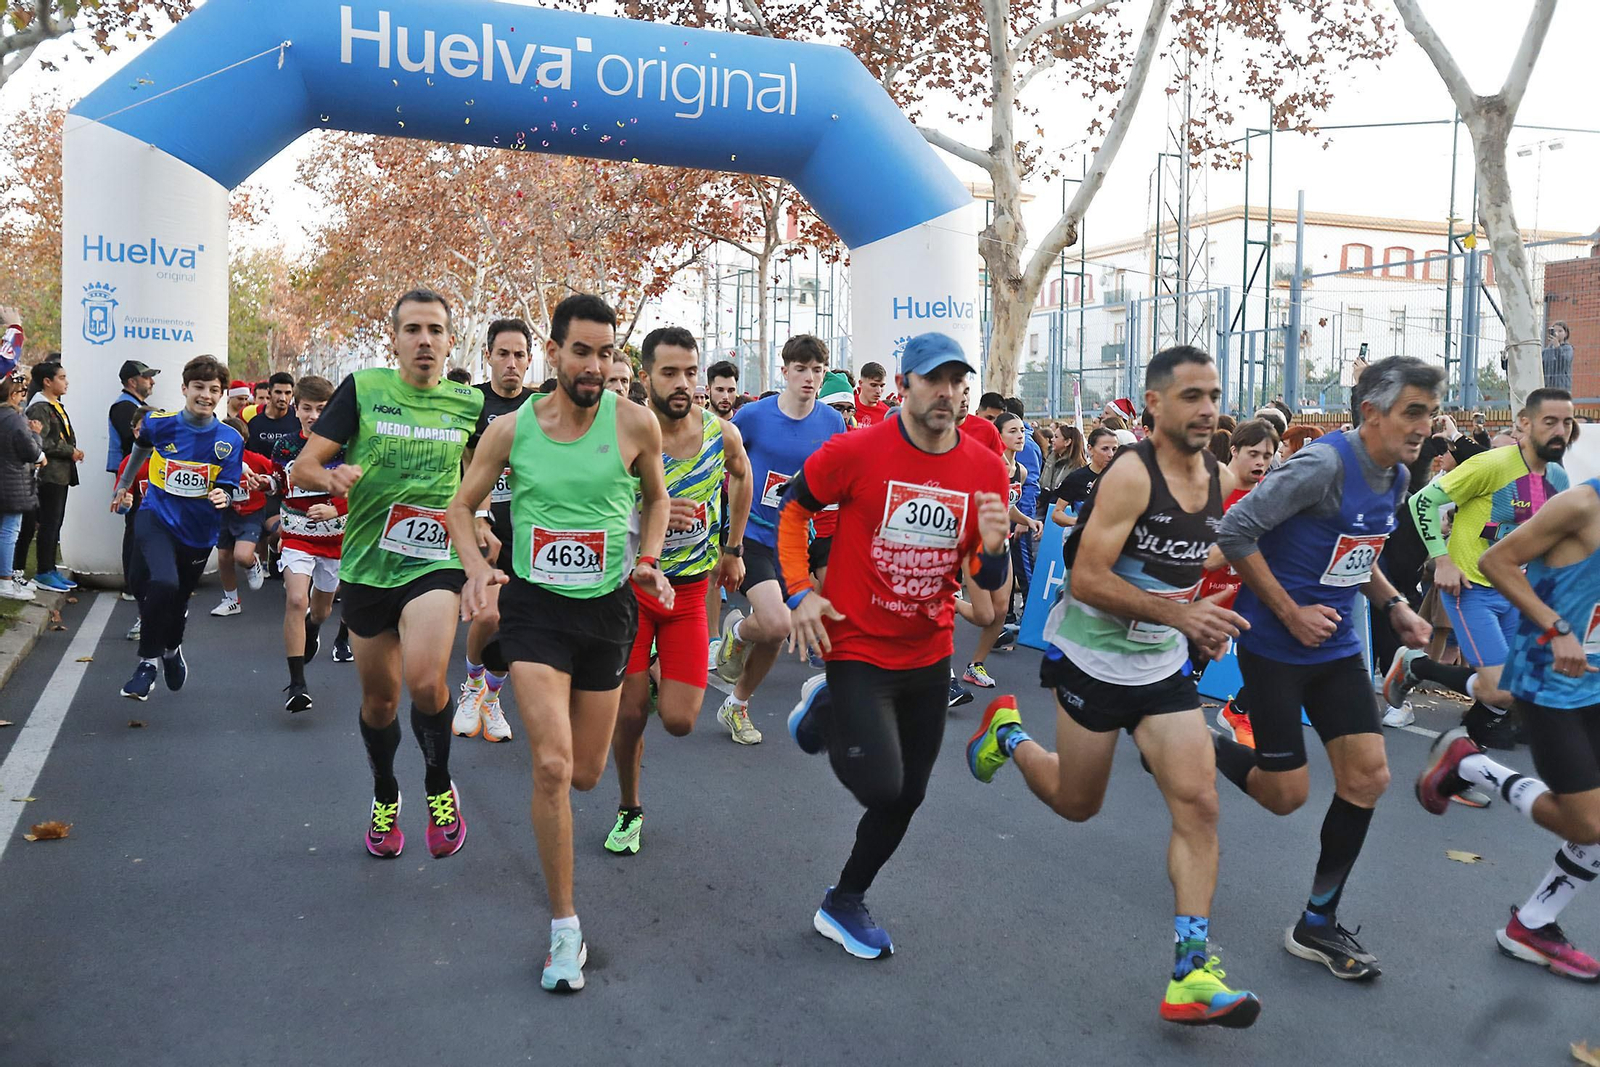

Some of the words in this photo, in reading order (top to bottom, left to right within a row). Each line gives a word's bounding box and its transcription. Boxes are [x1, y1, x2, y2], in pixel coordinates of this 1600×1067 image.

[339, 5, 572, 90] Huelva
[596, 46, 797, 119] original
[83, 235, 195, 269] Huelva
[156, 271, 195, 282] original
[893, 295, 974, 319] Huelva
[124, 315, 184, 326] Ayuntamiento
[124, 326, 194, 342] HUELVA
[454, 387, 472, 395] 2023
[372, 404, 402, 415] HOKA
[376, 421, 410, 437] MEDIO
[174, 471, 199, 486] 485
[905, 501, 945, 528] 300
[406, 519, 439, 542] 123
[546, 545, 586, 567] 463
[1346, 549, 1372, 569] 533
[891, 575, 943, 597] 2023
[871, 593, 919, 611] Huelva
